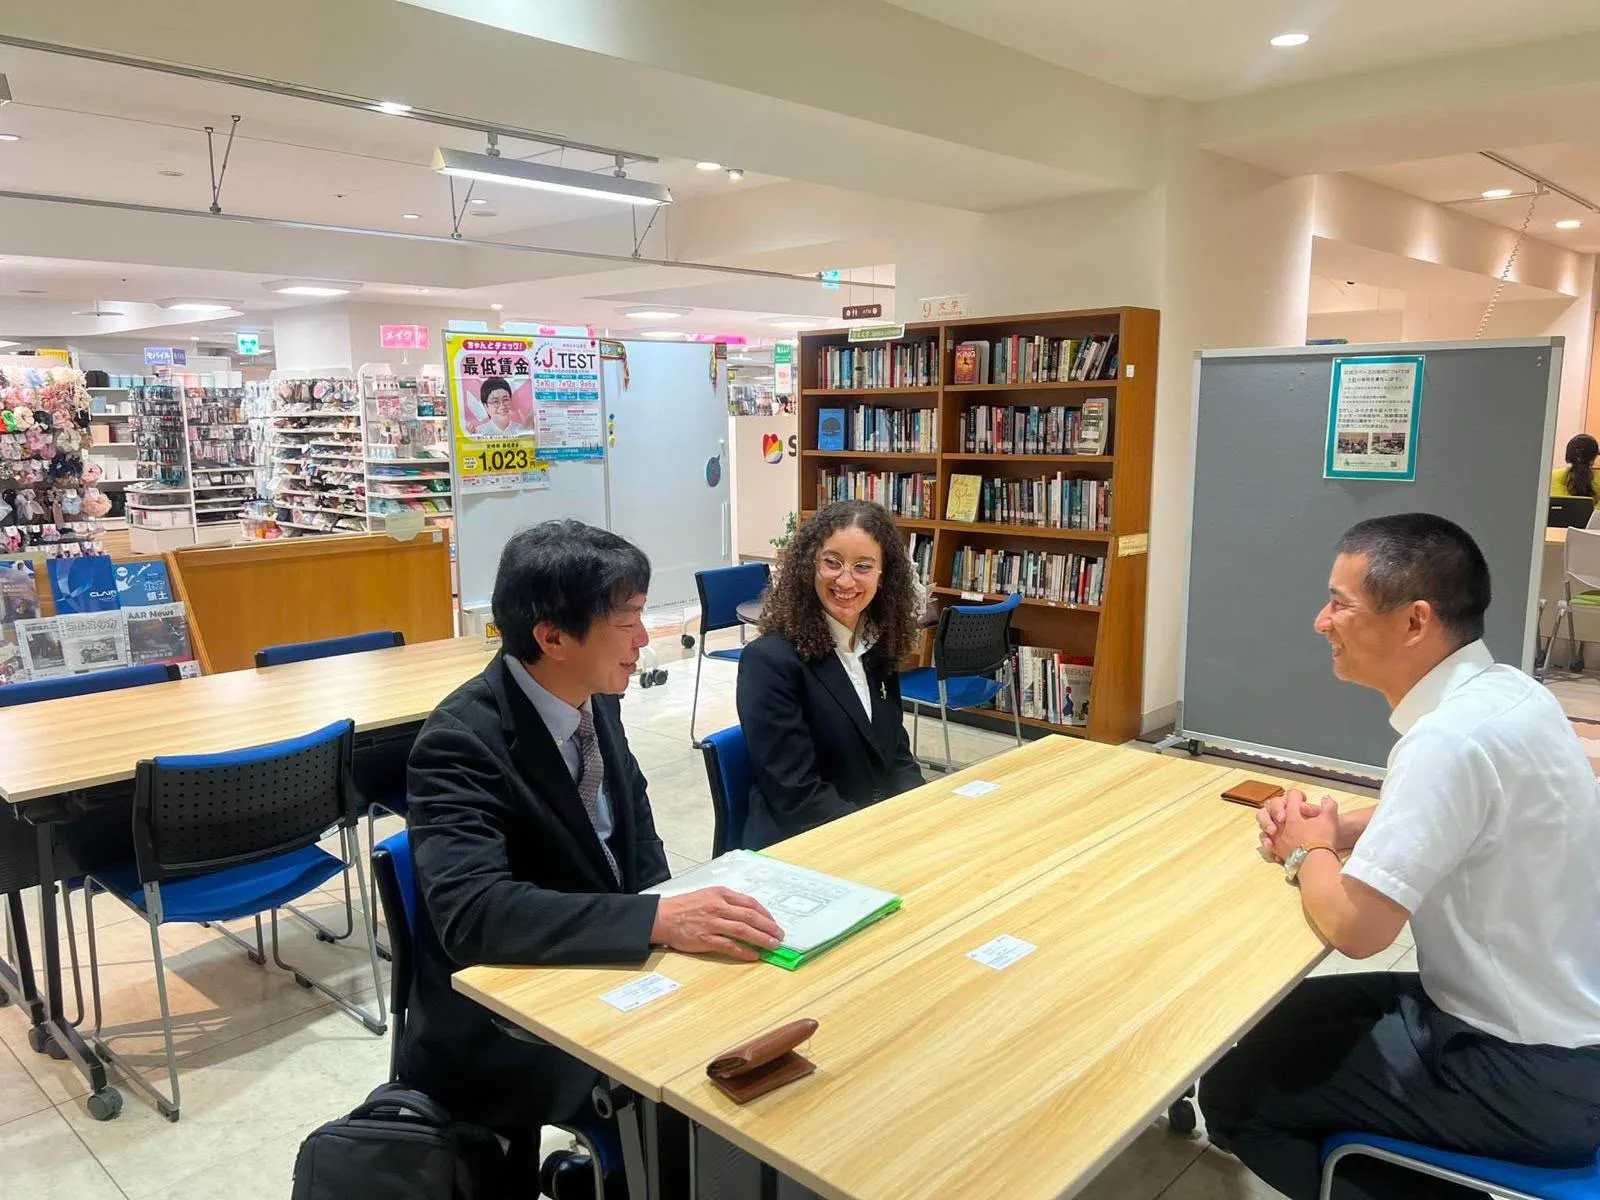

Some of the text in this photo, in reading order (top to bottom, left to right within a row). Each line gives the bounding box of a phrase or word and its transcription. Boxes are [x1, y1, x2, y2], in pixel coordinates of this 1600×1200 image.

[923, 301, 931, 318] 9
[542, 348, 596, 369] J.TEST
[956, 350, 976, 358] KING
[463, 357, 529, 375] 最低賃金
[788, 435, 797, 457] S
[479, 450, 528, 471] 1,023
[149, 610, 174, 618] News
